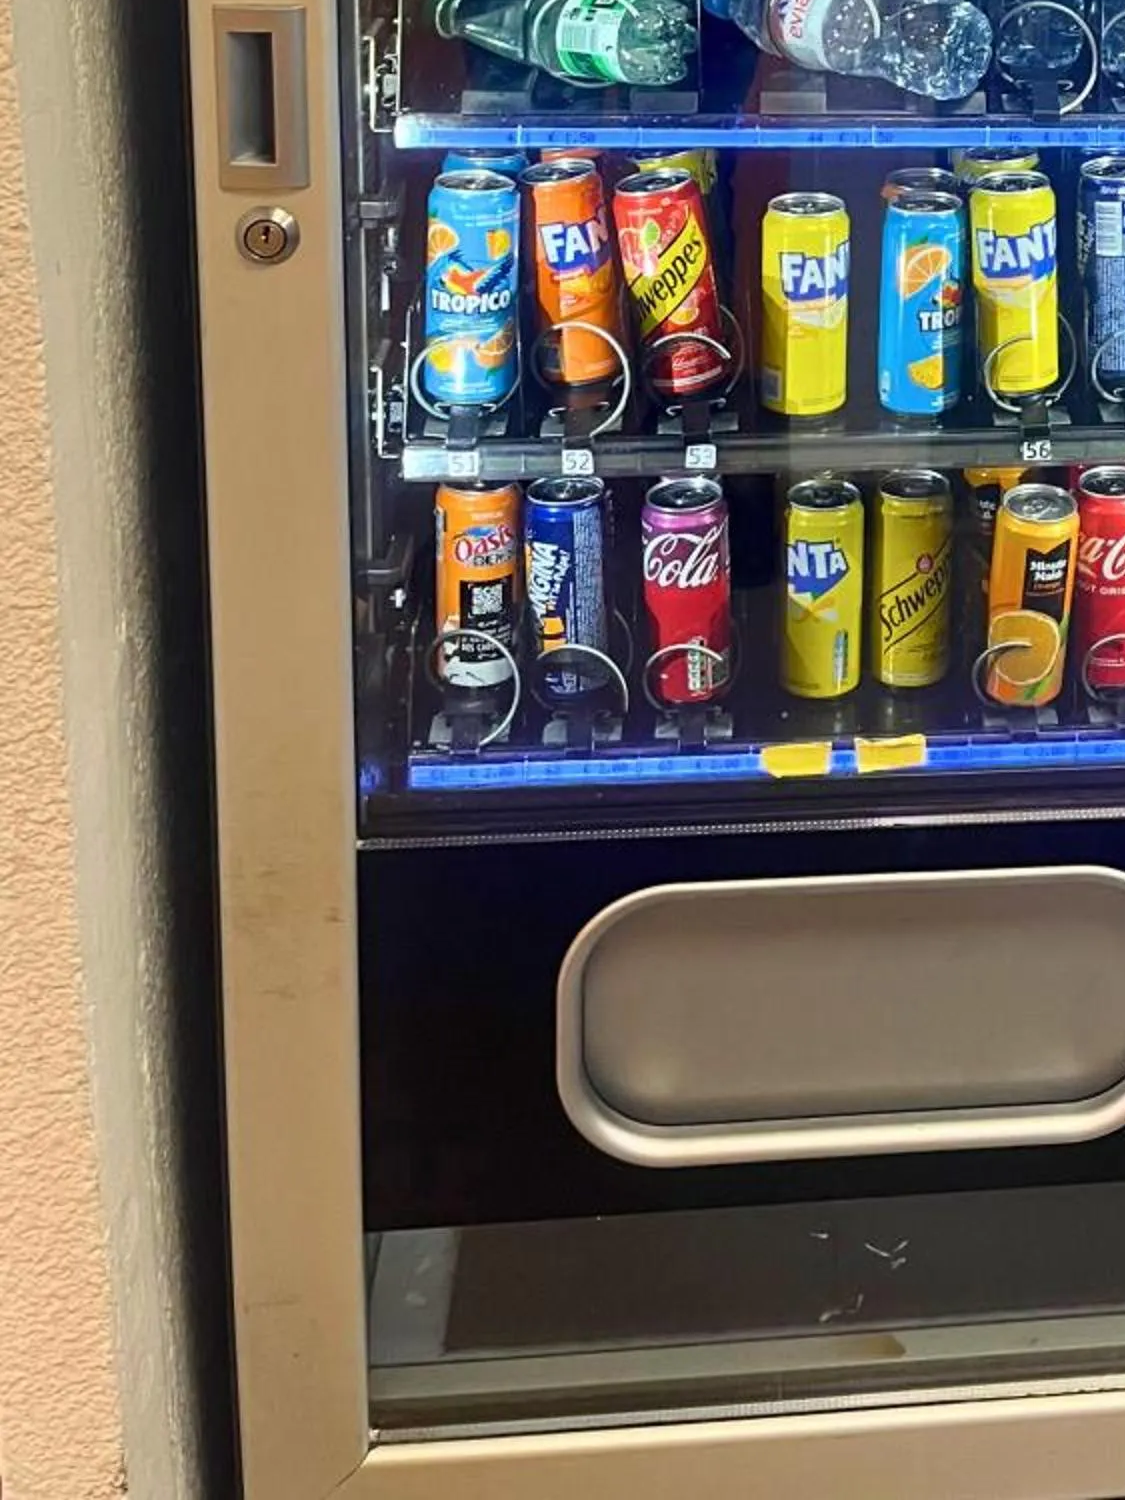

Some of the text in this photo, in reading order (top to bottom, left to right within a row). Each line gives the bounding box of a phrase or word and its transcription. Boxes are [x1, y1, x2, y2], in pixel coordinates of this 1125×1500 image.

[540, 214, 610, 263] FAN
[976, 217, 1057, 275] FANT
[639, 238, 703, 321] weppes
[780, 241, 850, 294] FAN
[431, 289, 511, 313] TROPICO
[450, 452, 476, 474] 51
[565, 452, 590, 471] 52
[687, 445, 714, 466] 53
[455, 523, 515, 562] Oasis
[642, 523, 725, 589] Cola
[788, 539, 847, 580] NTA
